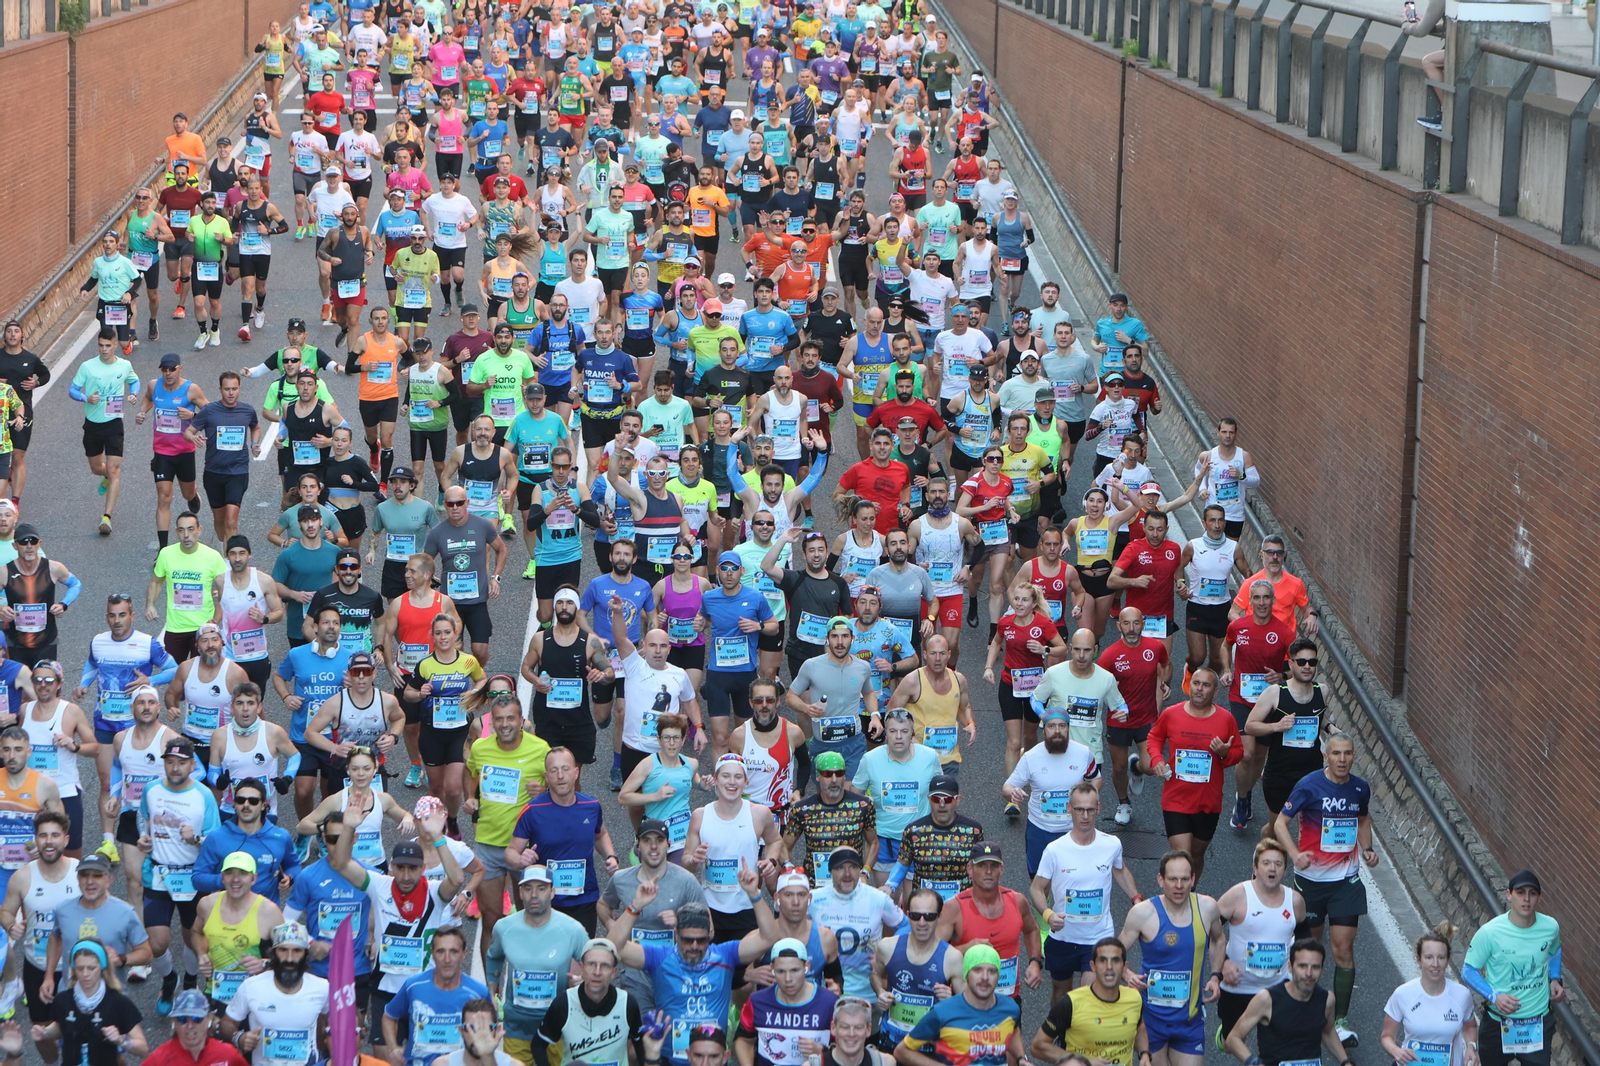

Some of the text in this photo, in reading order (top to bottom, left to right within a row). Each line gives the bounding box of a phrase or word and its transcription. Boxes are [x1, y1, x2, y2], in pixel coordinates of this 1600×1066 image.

[494, 376, 516, 384] sano
[319, 672, 335, 681] GO
[494, 769, 516, 777] ZURICH
[1322, 797, 1346, 812] RAC
[903, 997, 927, 1005] ZURICH
[431, 1016, 456, 1024] ZURICH
[765, 1011, 820, 1027] XANDER
[1422, 1044, 1445, 1052] ZURICH
